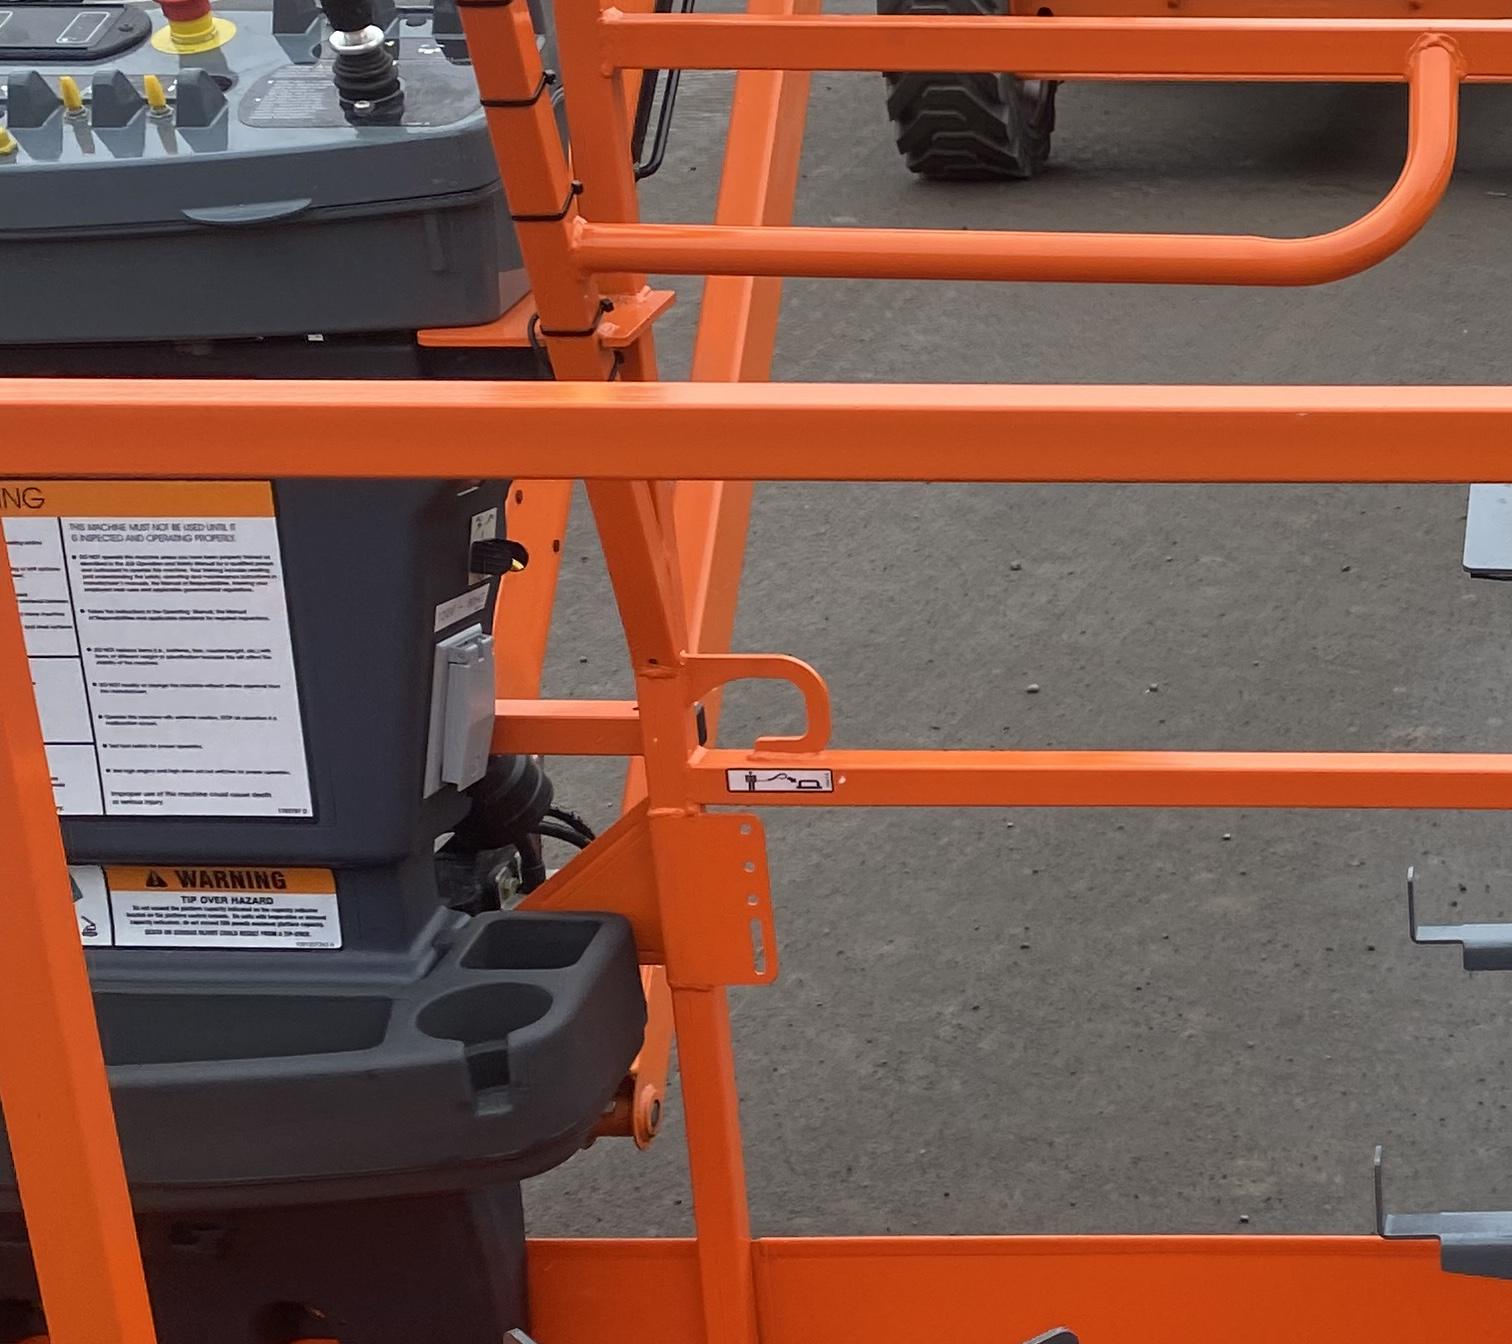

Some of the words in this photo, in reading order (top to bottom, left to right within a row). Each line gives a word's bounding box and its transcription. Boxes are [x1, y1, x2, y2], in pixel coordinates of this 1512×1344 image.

[129, 523, 150, 531] MUST
[152, 523, 169, 531] NOT
[184, 523, 206, 531] USED
[126, 534, 144, 542] AND
[146, 534, 192, 542] OPERATING
[174, 870, 287, 889] WARNING
[180, 896, 196, 904] TIP
[200, 896, 228, 904] OVER
[231, 896, 274, 905] HAZARD
